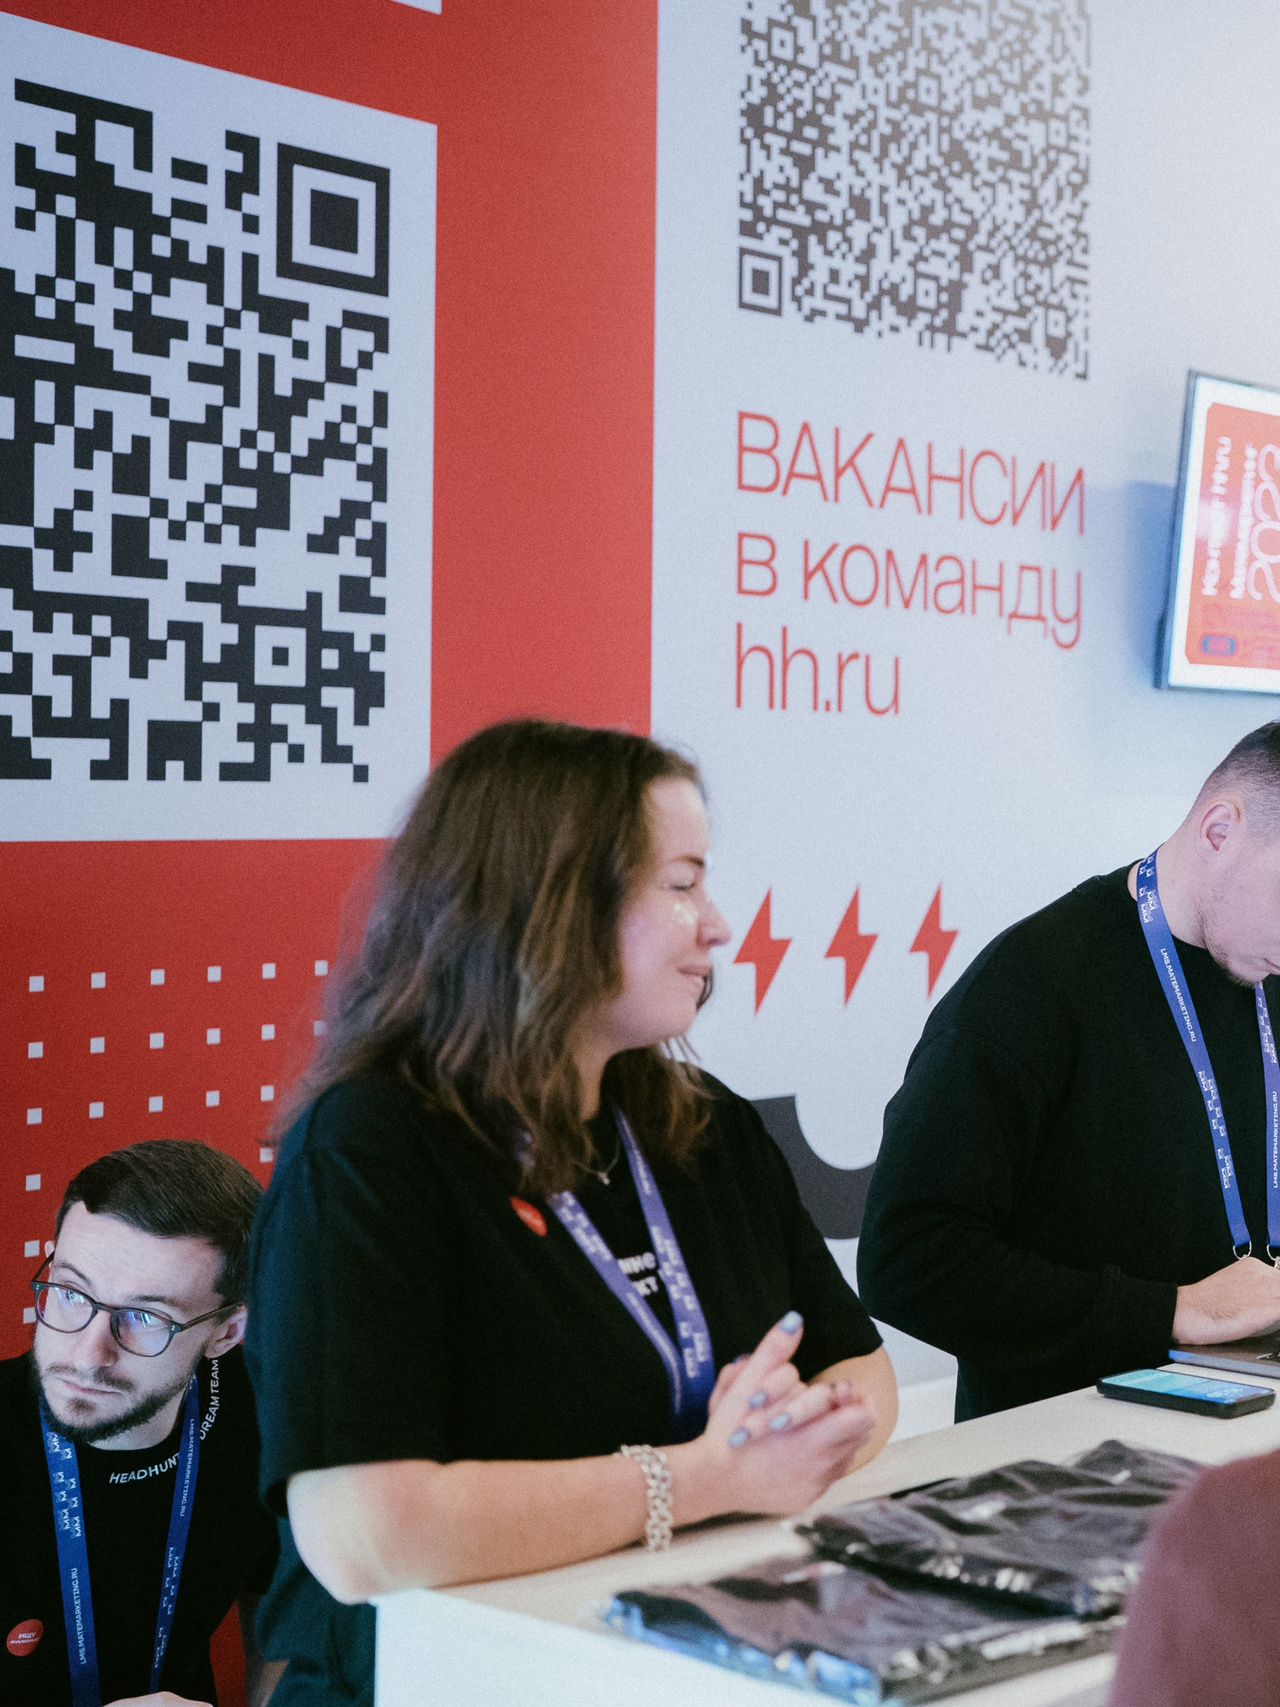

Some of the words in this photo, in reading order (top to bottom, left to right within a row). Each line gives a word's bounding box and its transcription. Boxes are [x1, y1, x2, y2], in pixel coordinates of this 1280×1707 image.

[736, 410, 1084, 536] ВАКАНСИИ
[802, 538, 1082, 650] команду
[736, 622, 900, 715] hh.ru
[109, 1453, 181, 1485] HEADHUNT
[210, 1360, 220, 1394] TEAM
